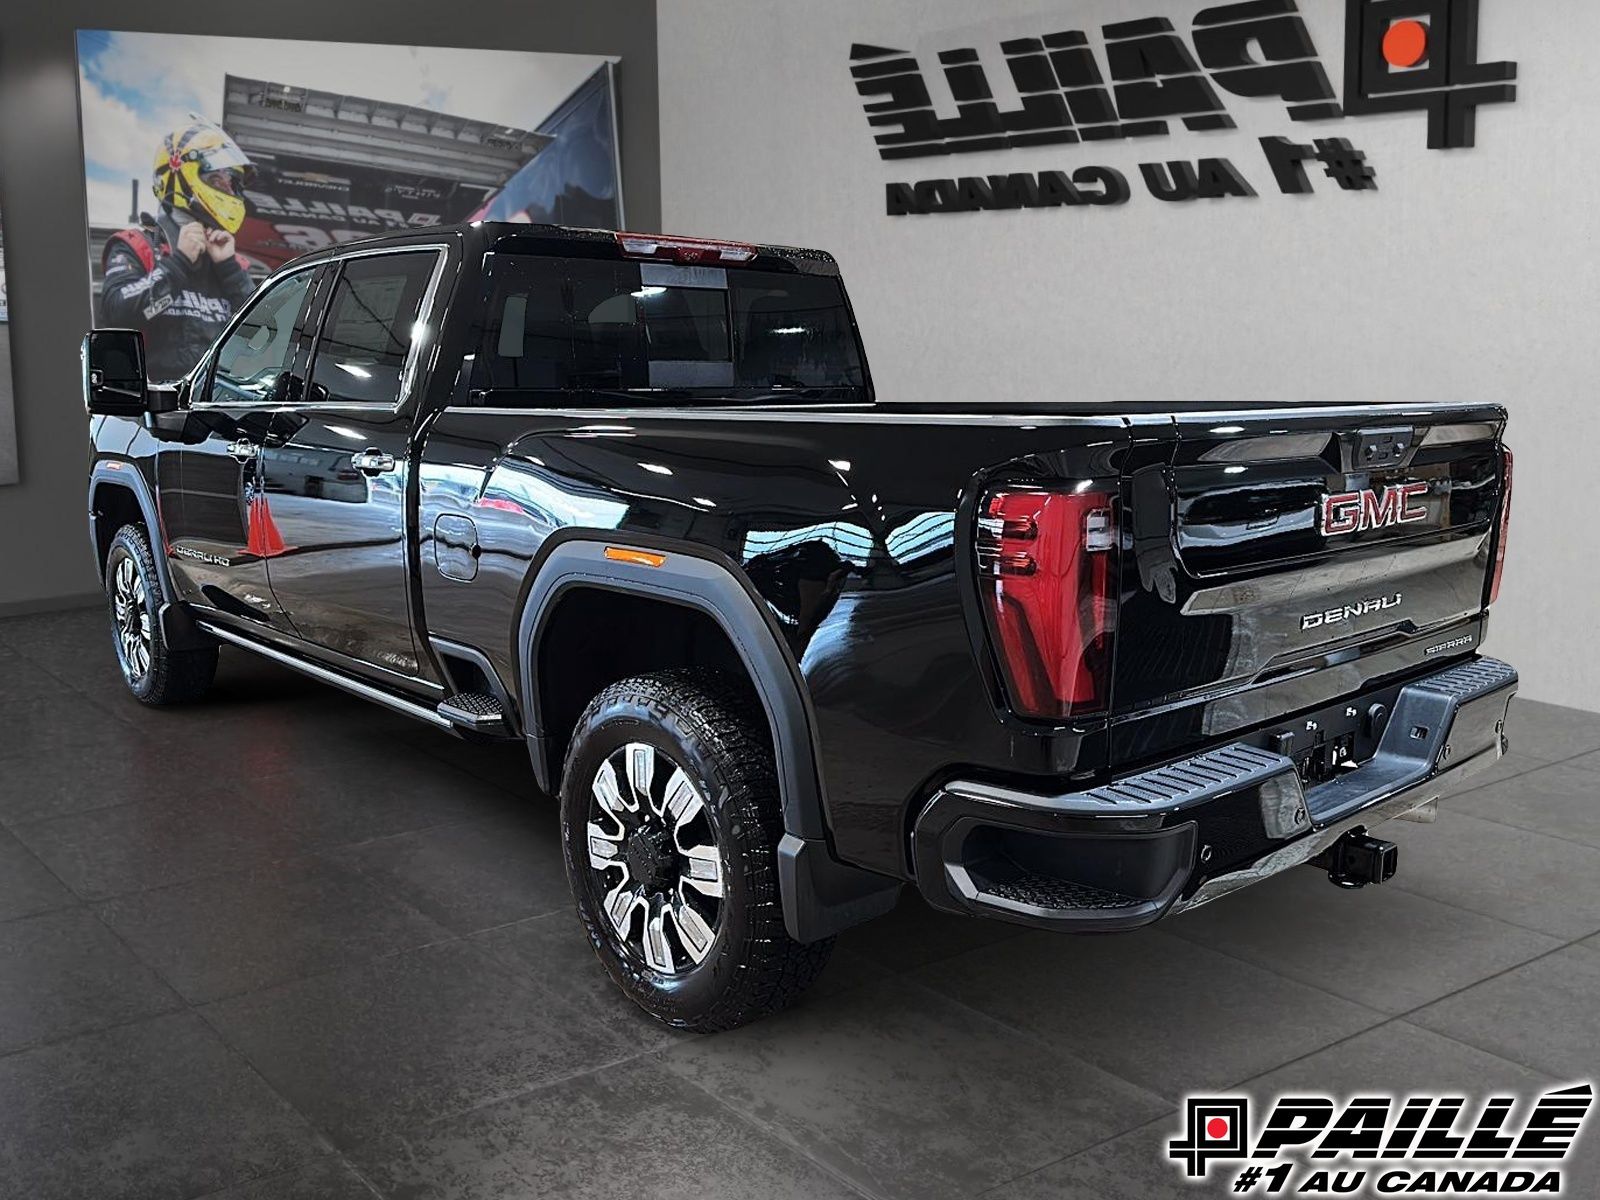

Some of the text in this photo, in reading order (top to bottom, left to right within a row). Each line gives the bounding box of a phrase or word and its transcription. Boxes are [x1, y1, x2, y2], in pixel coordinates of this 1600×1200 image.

[1320, 482, 1428, 536] GMC
[1302, 593, 1402, 630] DENALI
[1425, 634, 1473, 655] SIERRA
